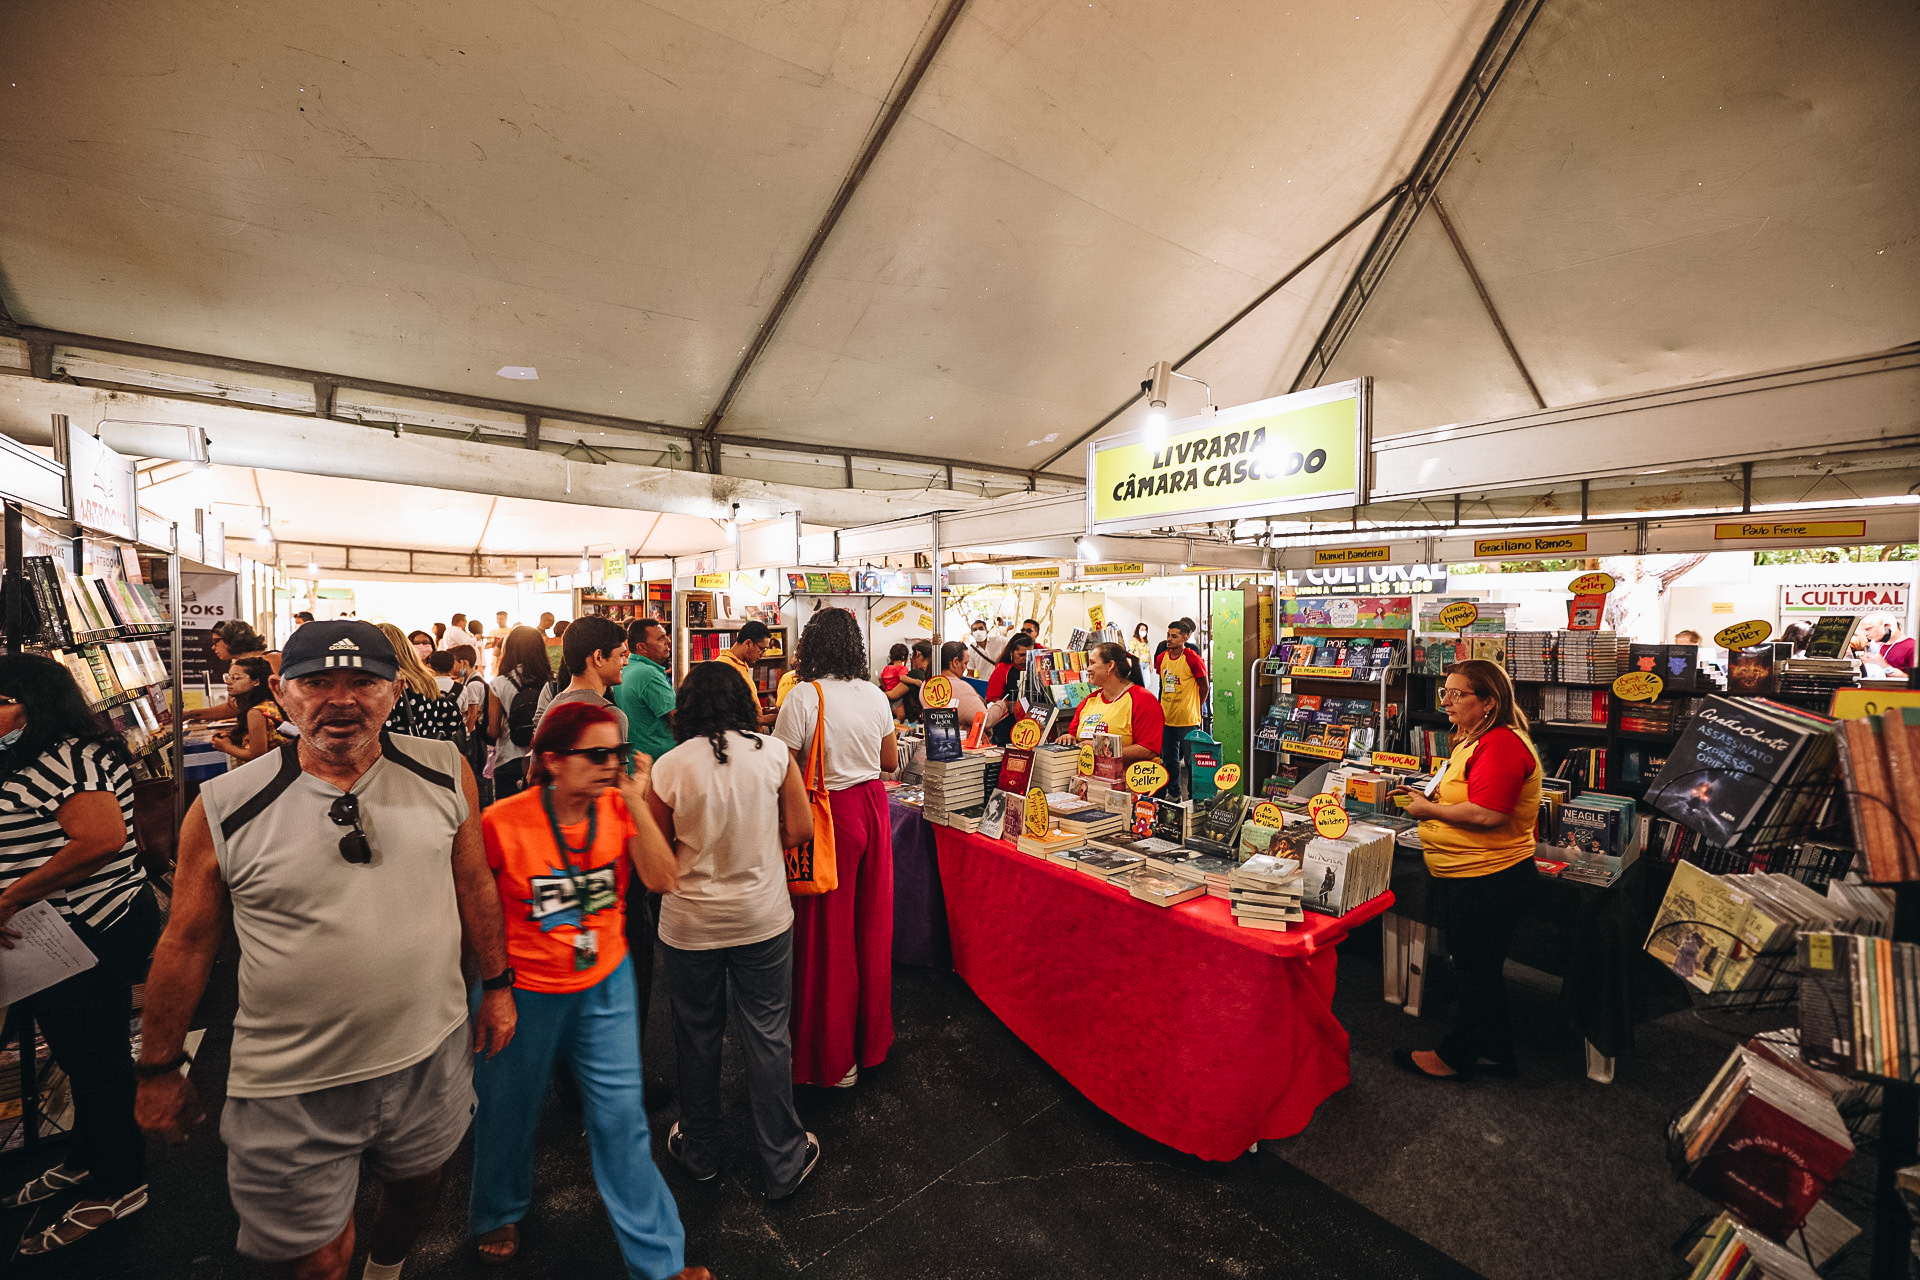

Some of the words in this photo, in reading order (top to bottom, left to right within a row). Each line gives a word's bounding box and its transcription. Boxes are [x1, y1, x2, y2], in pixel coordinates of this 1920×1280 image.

[1153, 426, 1266, 469] LIVRARIA
[1113, 467, 1198, 501] CÂMARA
[1743, 525, 1769, 535] Paulo
[1774, 525, 1807, 534] Freire
[1479, 541, 1532, 552] Graciliano
[1535, 539, 1573, 550] Ramos
[1319, 552, 1345, 561] Manuel
[1348, 548, 1384, 559] Bandeira
[1114, 564, 1123, 573] Ruy
[1575, 582, 1607, 590] Seller
[1801, 590, 1904, 606] CULTURAL
[1724, 623, 1752, 636] Best
[1326, 640, 1347, 648] POE
[1721, 629, 1762, 646] Seller
[1620, 675, 1640, 686] Best
[1621, 683, 1648, 695] Seller
[1324, 699, 1343, 707] Anne
[1348, 700, 1368, 709] Anne
[1699, 708, 1742, 735] Agatha
[1740, 727, 1790, 751] Christie
[1697, 725, 1774, 764] ASSASSINATO
[1375, 753, 1416, 766] PROMOÇÃO
[1696, 741, 1755, 773] EXPRESSO
[1134, 764, 1157, 775] Best
[1131, 775, 1160, 787] Seller
[1321, 808, 1336, 816] THE
[1564, 809, 1604, 823] NEAGLE
